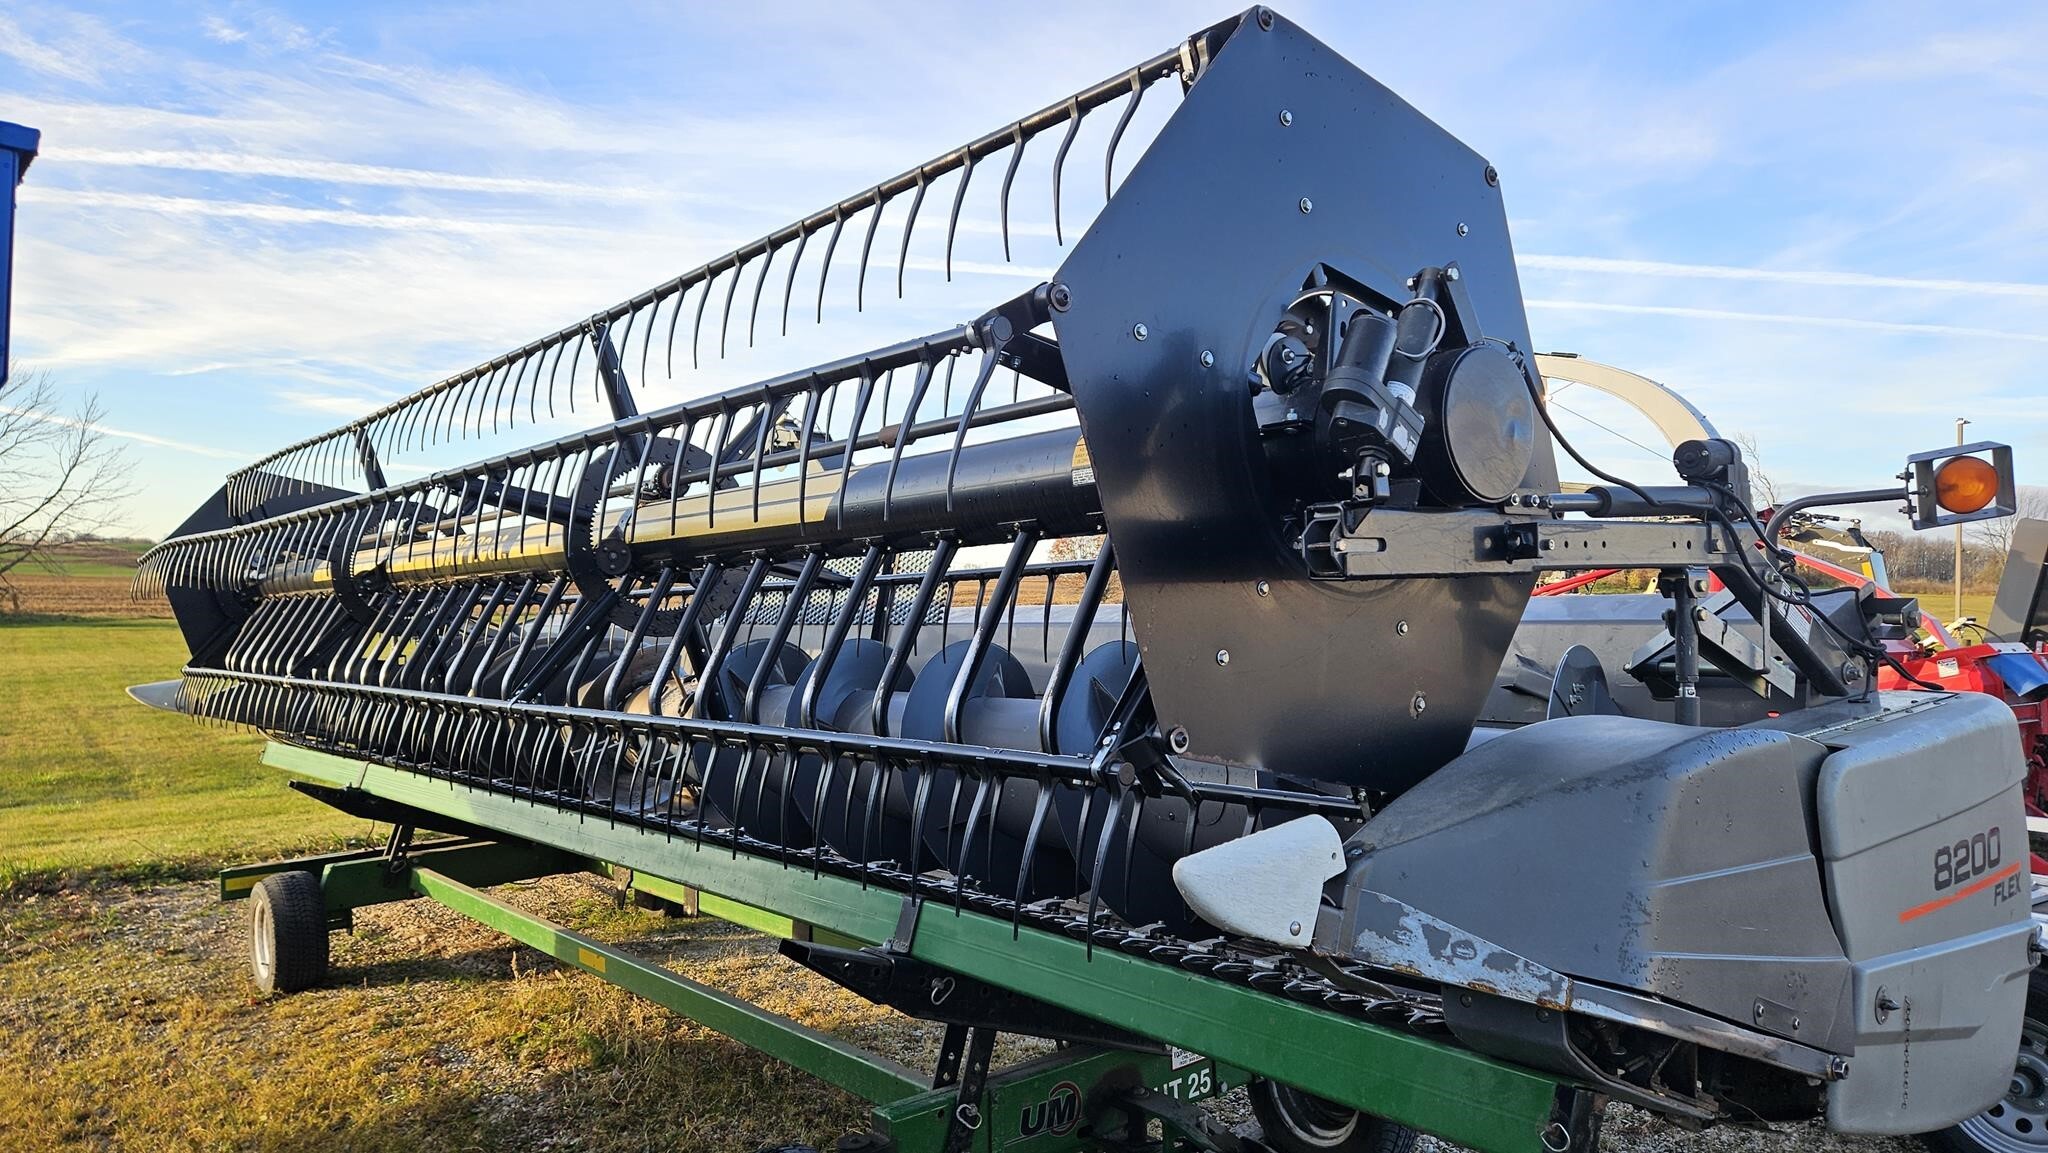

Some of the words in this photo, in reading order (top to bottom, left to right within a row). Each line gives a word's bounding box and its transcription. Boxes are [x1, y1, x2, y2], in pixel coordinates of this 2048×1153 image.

[1934, 826, 2001, 891] 8200
[1993, 872, 2021, 907] FLEX
[1187, 1067, 1211, 1099] 25
[1020, 1092, 1078, 1137] UM
